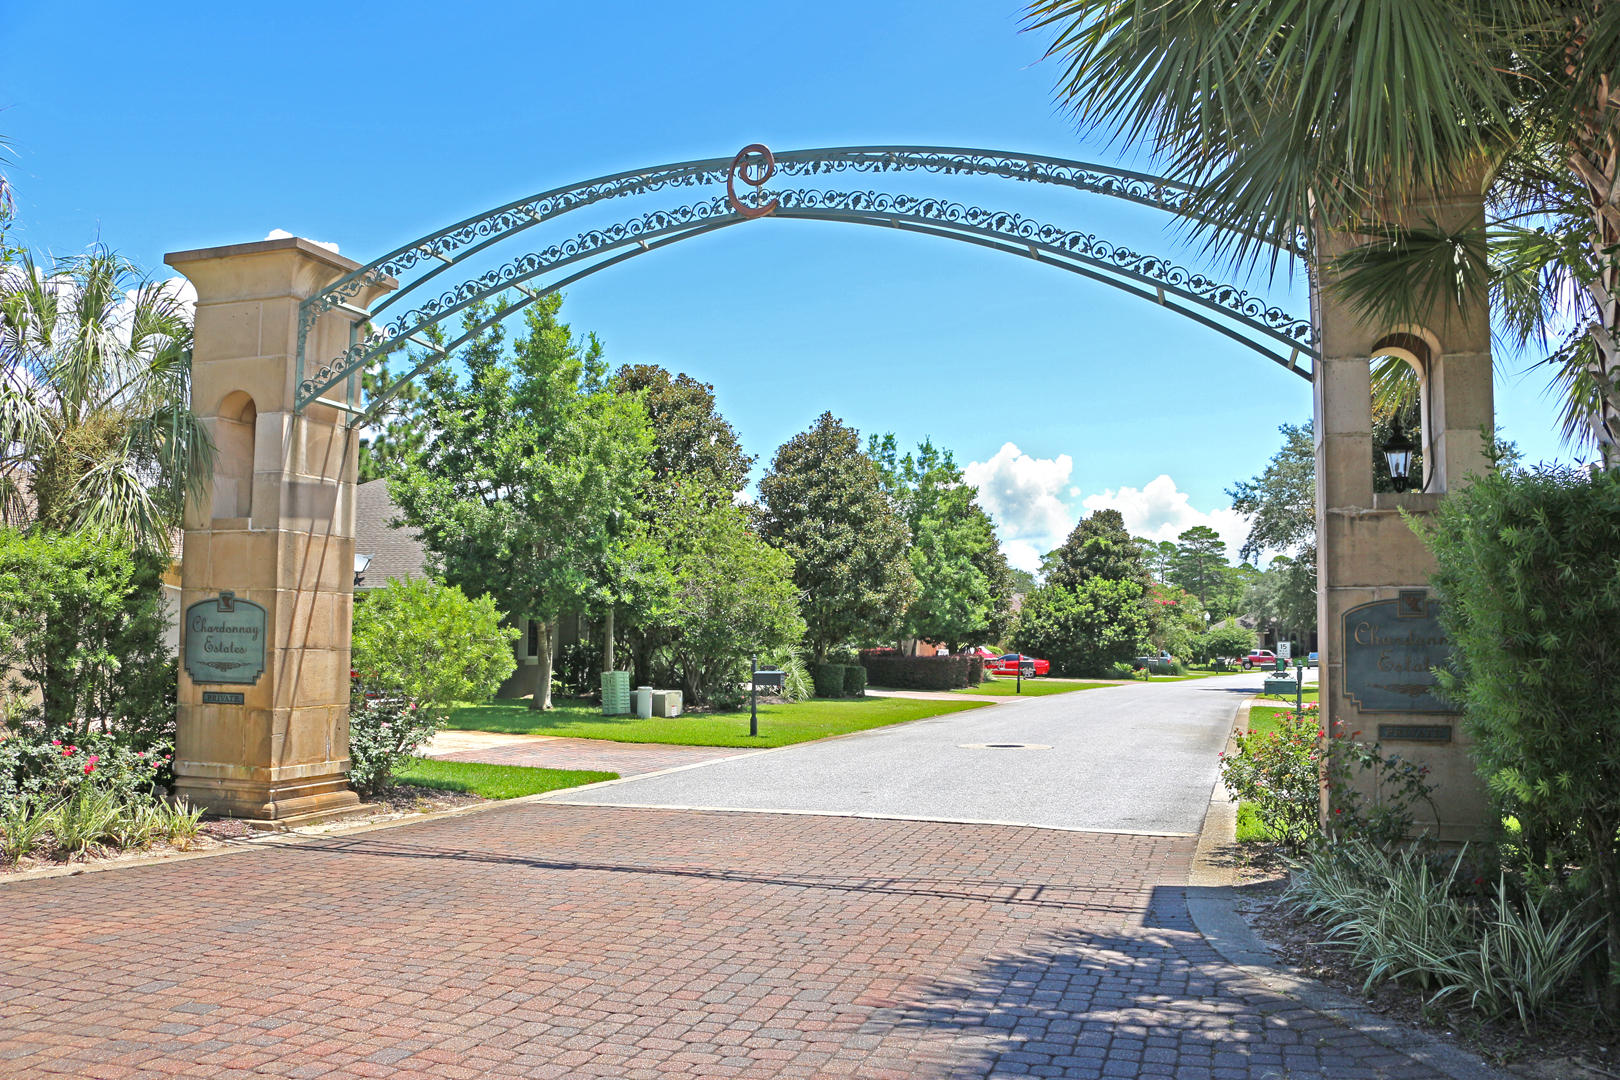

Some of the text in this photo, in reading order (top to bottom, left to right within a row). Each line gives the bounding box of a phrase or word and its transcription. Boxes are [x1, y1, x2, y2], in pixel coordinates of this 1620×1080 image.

[192, 616, 259, 640] Chardonnay
[1354, 621, 1449, 646] Chardonn
[203, 635, 247, 654] Estates
[1377, 649, 1431, 673] Estat
[206, 694, 241, 703] PRIVATE
